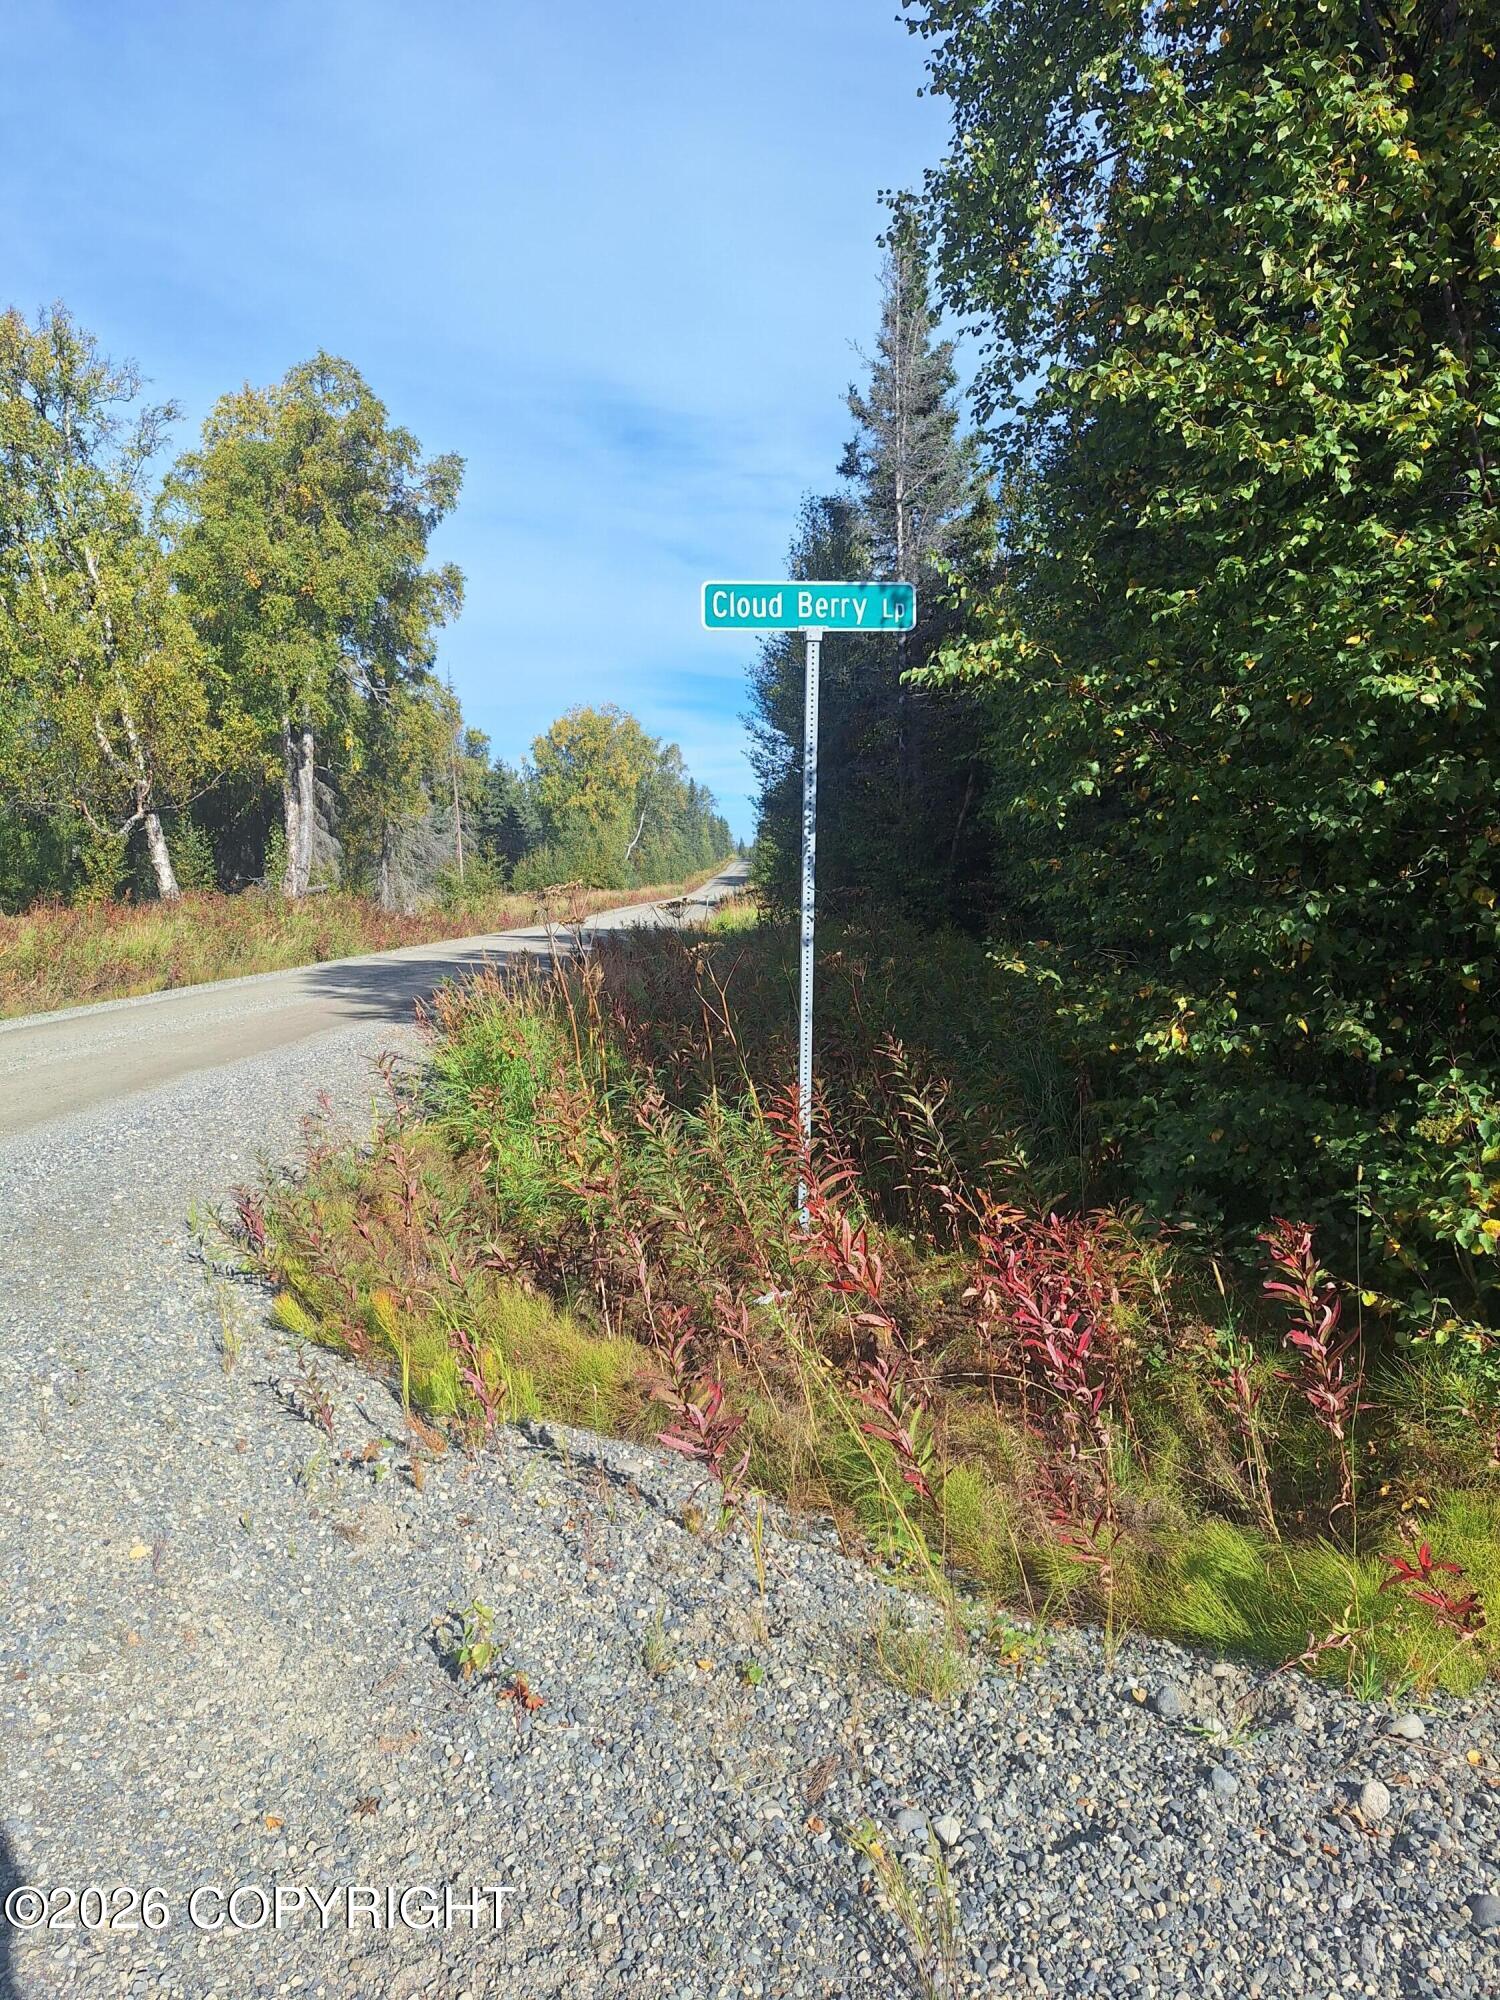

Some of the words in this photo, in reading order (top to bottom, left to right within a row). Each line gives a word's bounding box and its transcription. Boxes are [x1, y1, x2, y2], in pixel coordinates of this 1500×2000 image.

[712, 590, 783, 618] Cloud
[798, 591, 867, 625] Berry
[882, 599, 905, 623] Lp
